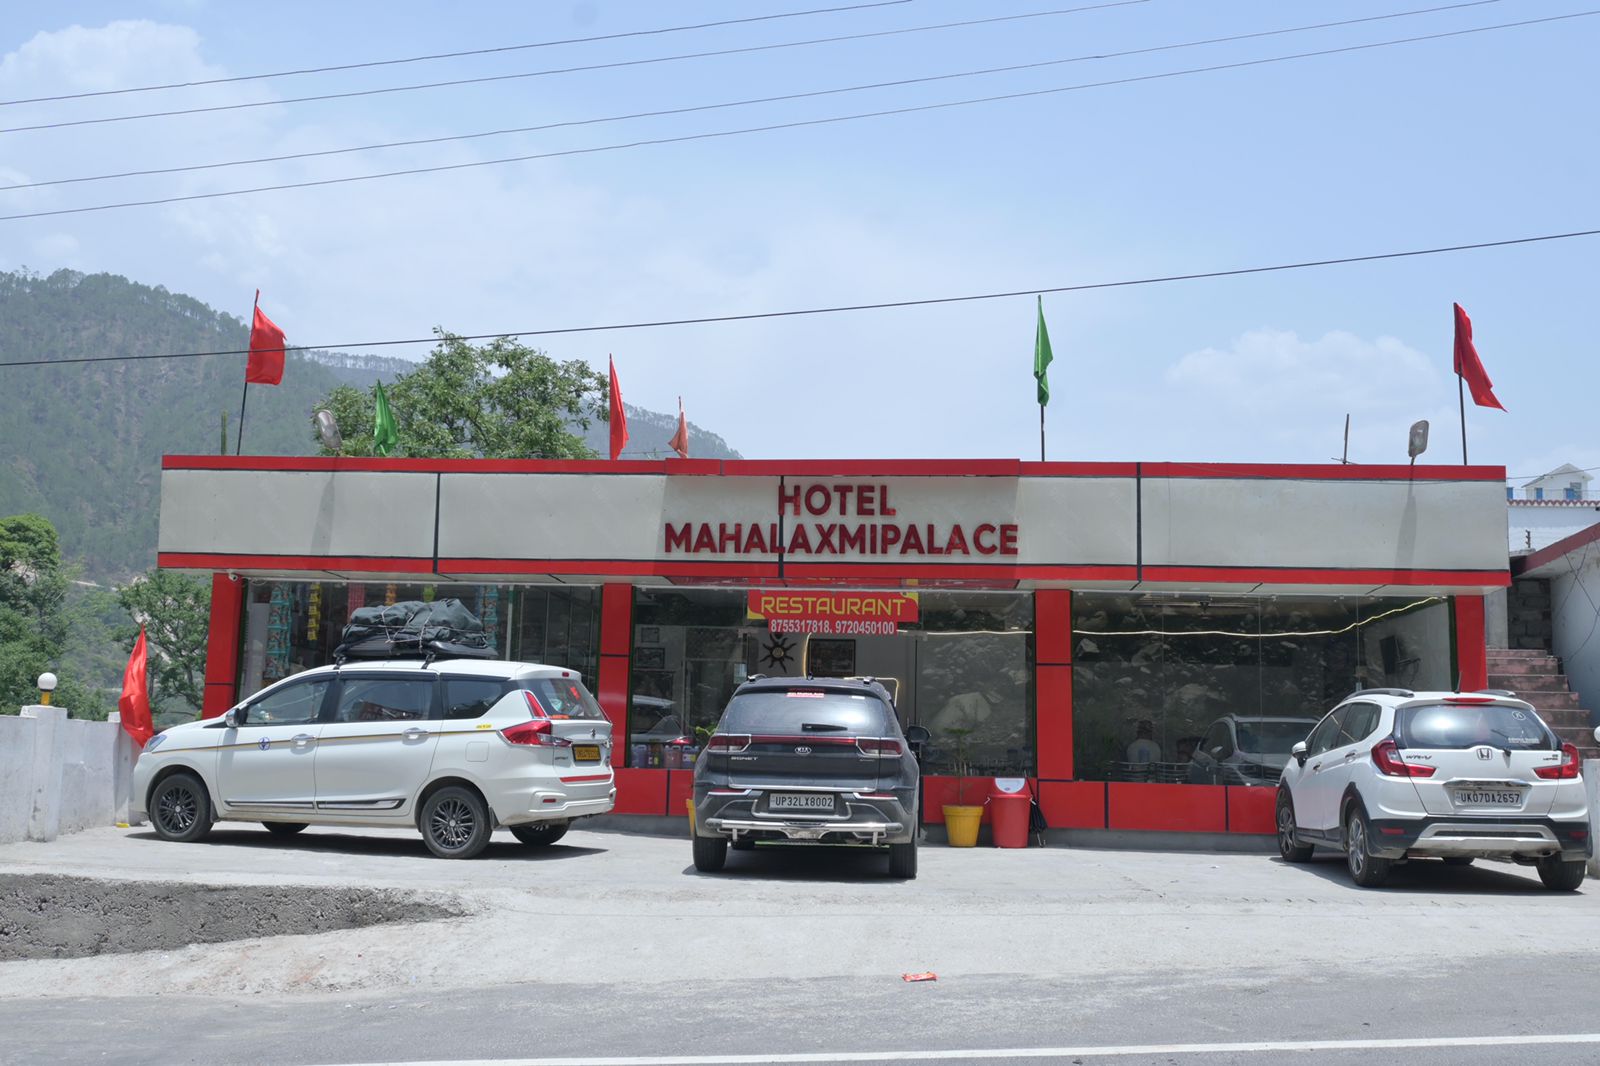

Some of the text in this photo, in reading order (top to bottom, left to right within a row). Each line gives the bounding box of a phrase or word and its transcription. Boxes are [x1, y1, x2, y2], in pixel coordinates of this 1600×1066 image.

[778, 484, 896, 516] HOTEL
[761, 596, 906, 616] RESTAURANT
[835, 620, 895, 634] 9720450100
[775, 796, 833, 807] UP32LX8002
[1461, 793, 1520, 803] UK07DA2657
